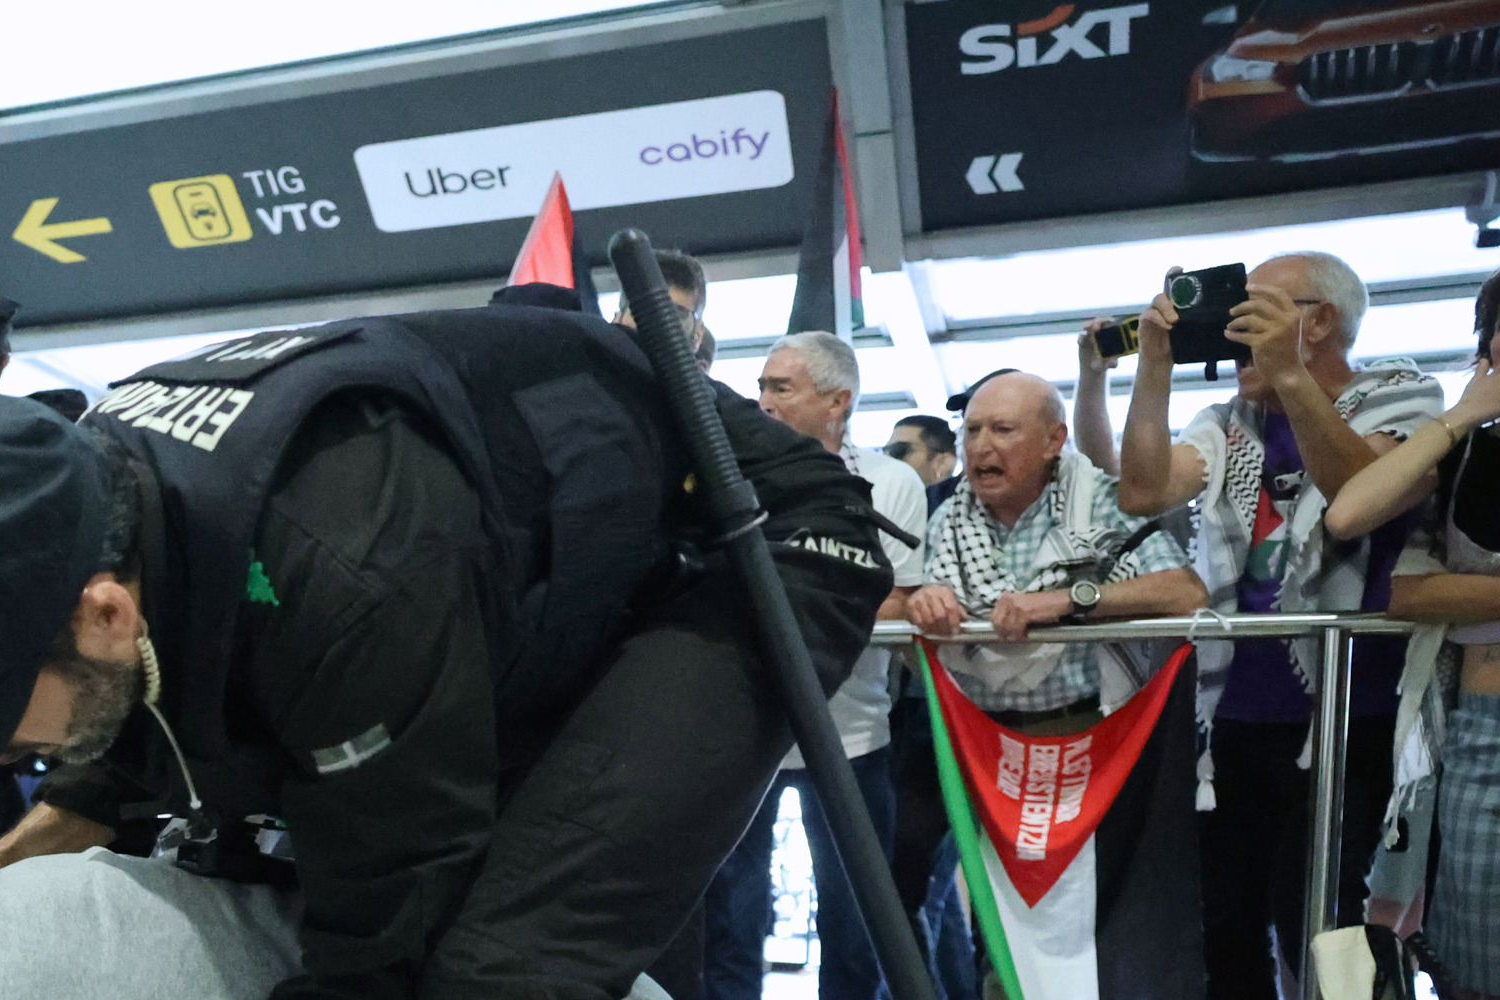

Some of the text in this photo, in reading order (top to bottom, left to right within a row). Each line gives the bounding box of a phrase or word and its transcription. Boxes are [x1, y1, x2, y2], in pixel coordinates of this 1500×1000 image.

[639, 127, 770, 166] cabify
[243, 165, 305, 197] TIG
[404, 165, 511, 198] Uber
[257, 199, 341, 235] VTC
[790, 536, 881, 569] AINTZA
